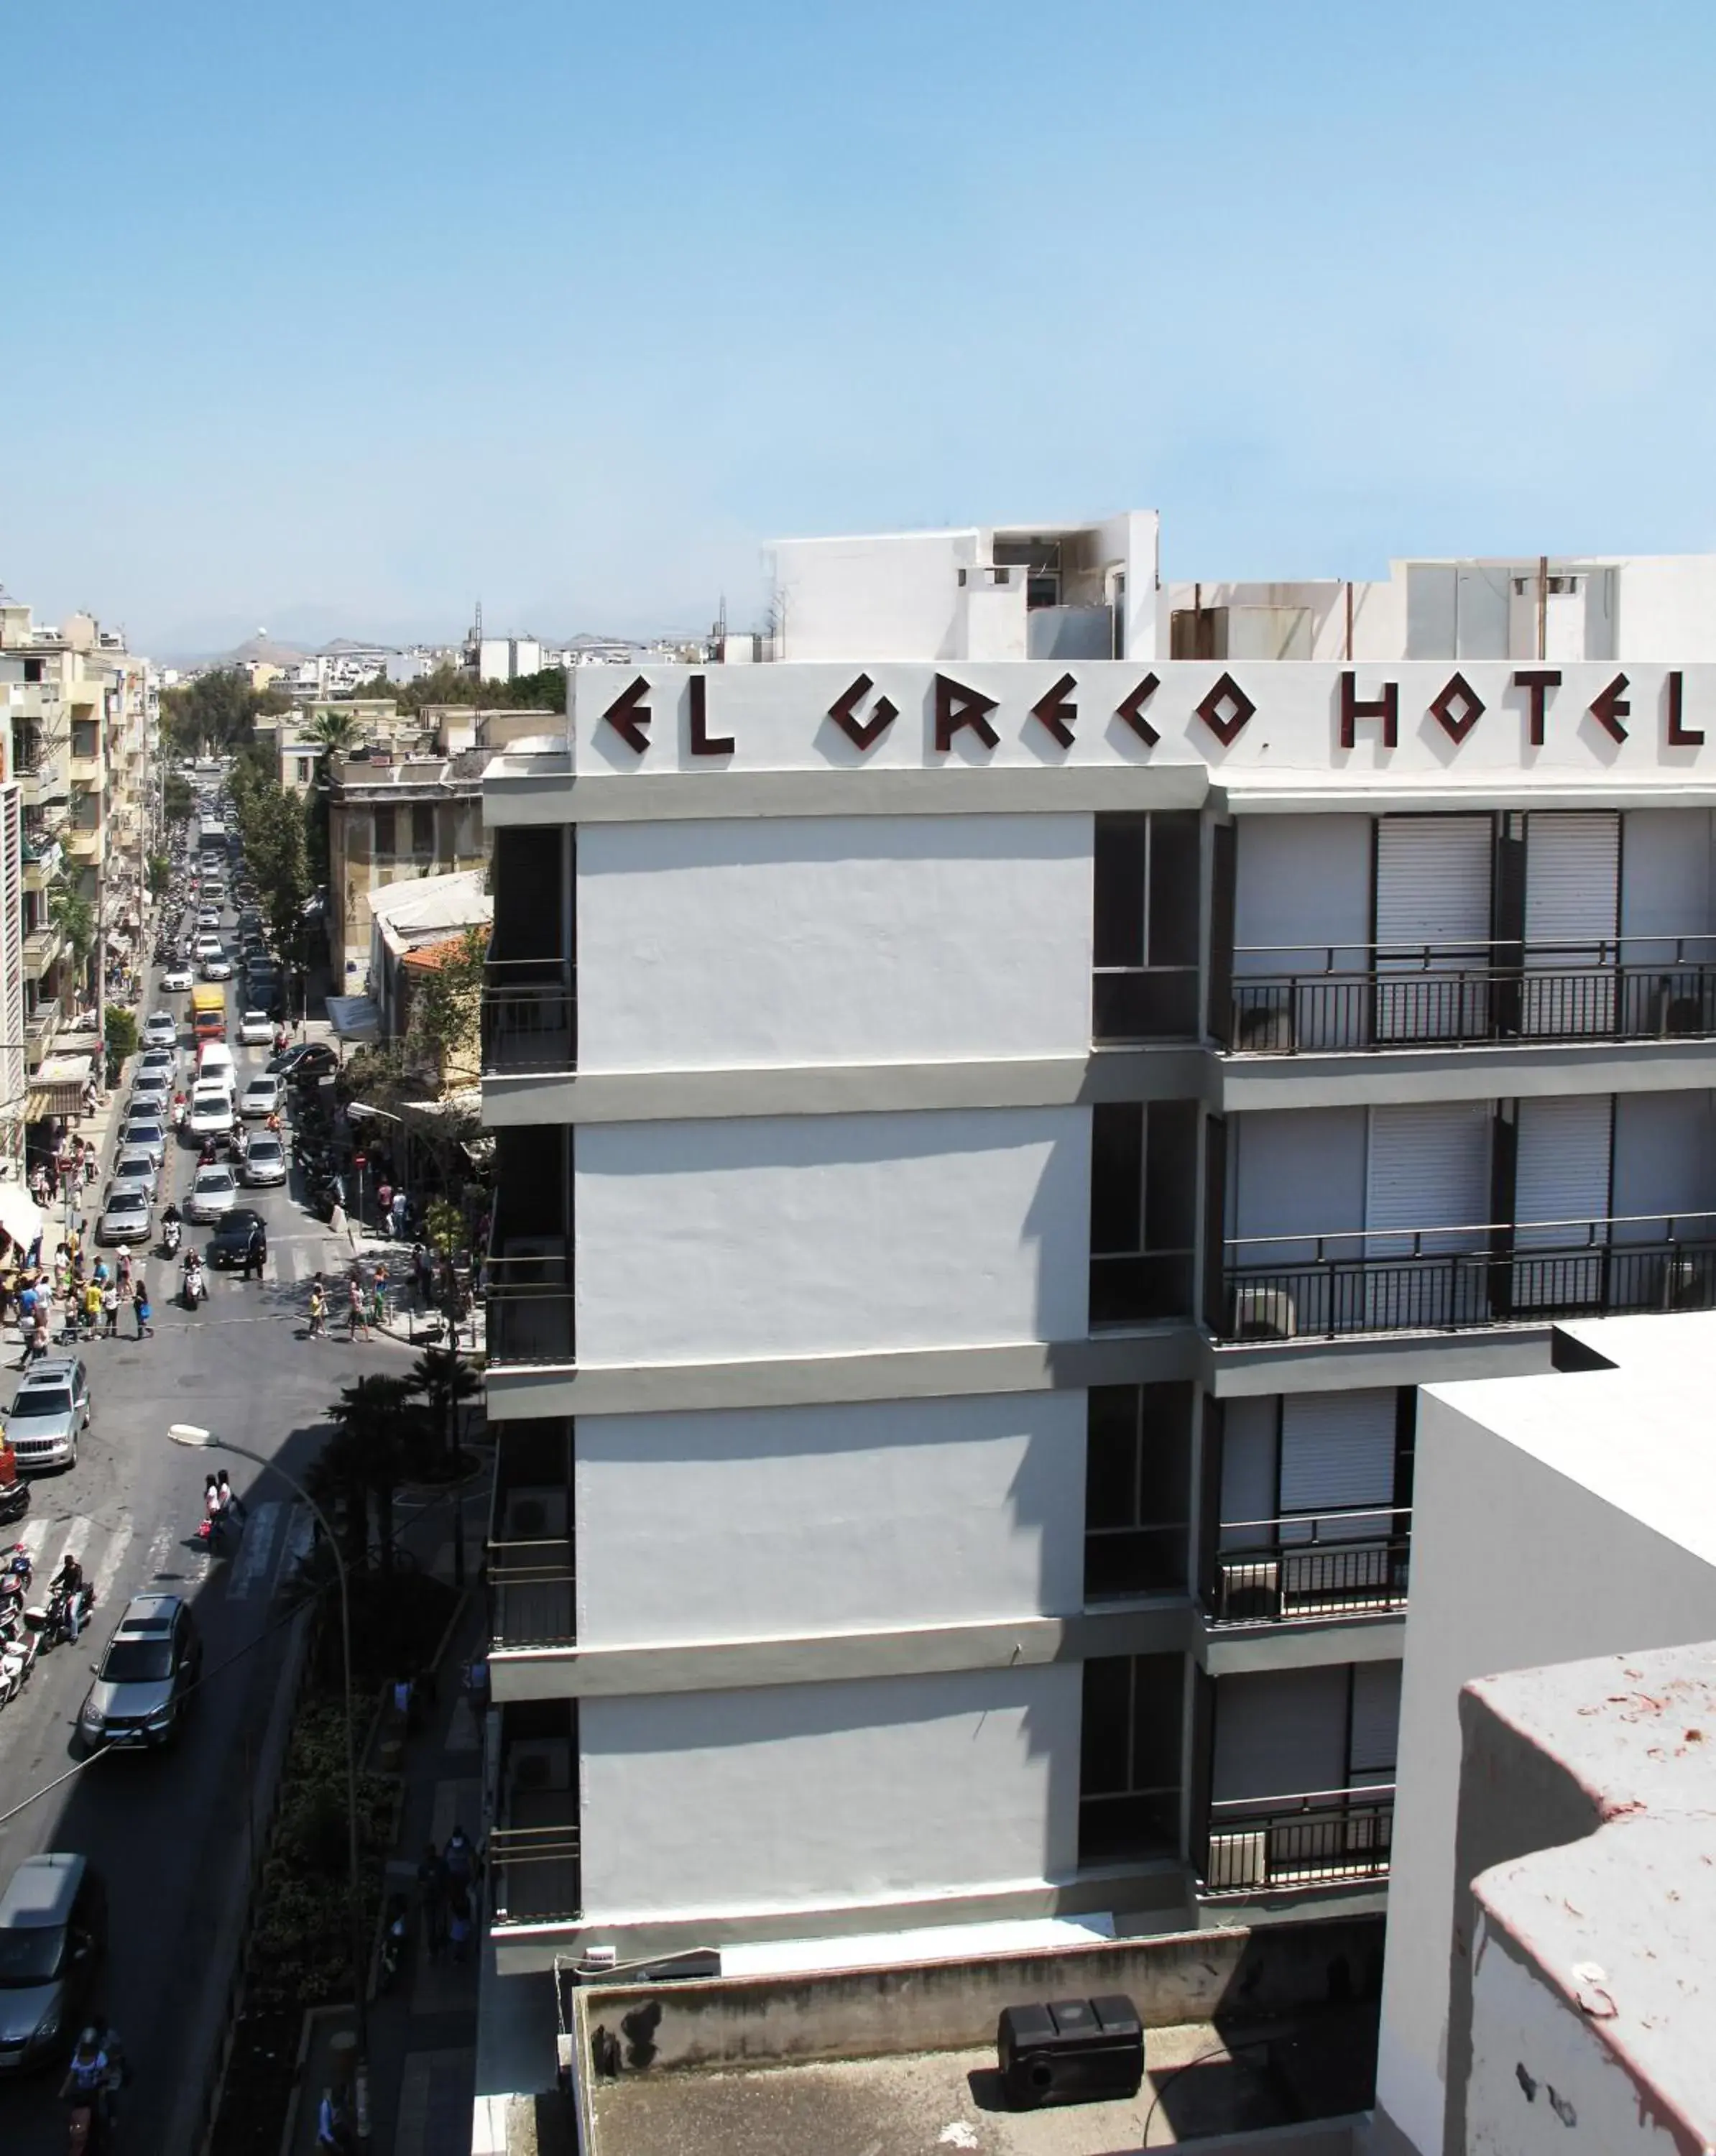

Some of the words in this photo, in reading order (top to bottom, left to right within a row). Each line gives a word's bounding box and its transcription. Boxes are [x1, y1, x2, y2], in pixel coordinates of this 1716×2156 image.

[602, 674, 735, 755] EL
[827, 672, 1257, 752] GRECO
[1340, 671, 1705, 749] HOTEL
